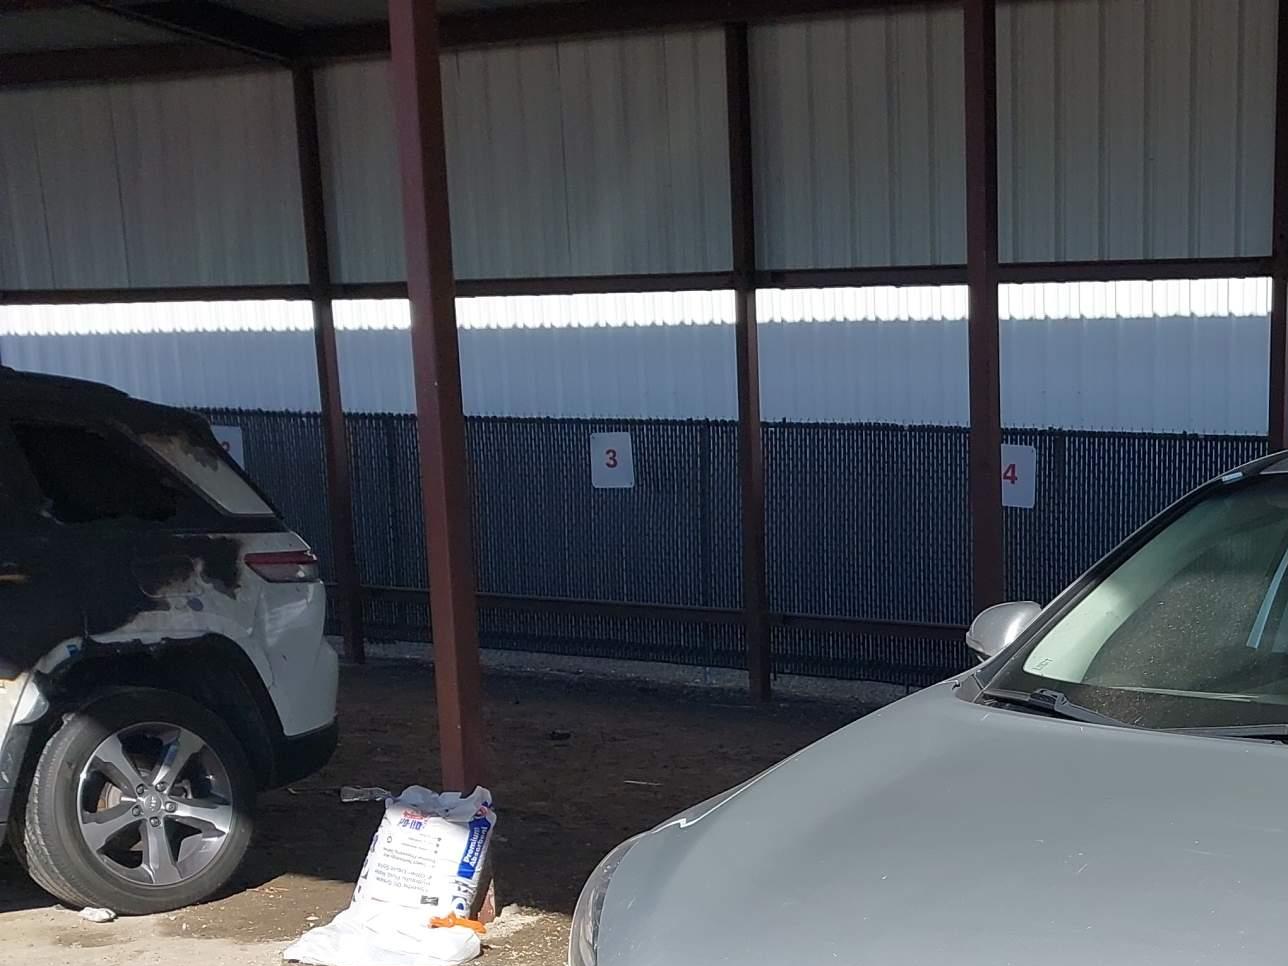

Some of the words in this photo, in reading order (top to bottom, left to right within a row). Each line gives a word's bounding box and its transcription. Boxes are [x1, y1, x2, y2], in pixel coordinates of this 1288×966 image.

[605, 448, 618, 468] 3
[1003, 463, 1018, 485] 4
[463, 827, 480, 864] Premium
